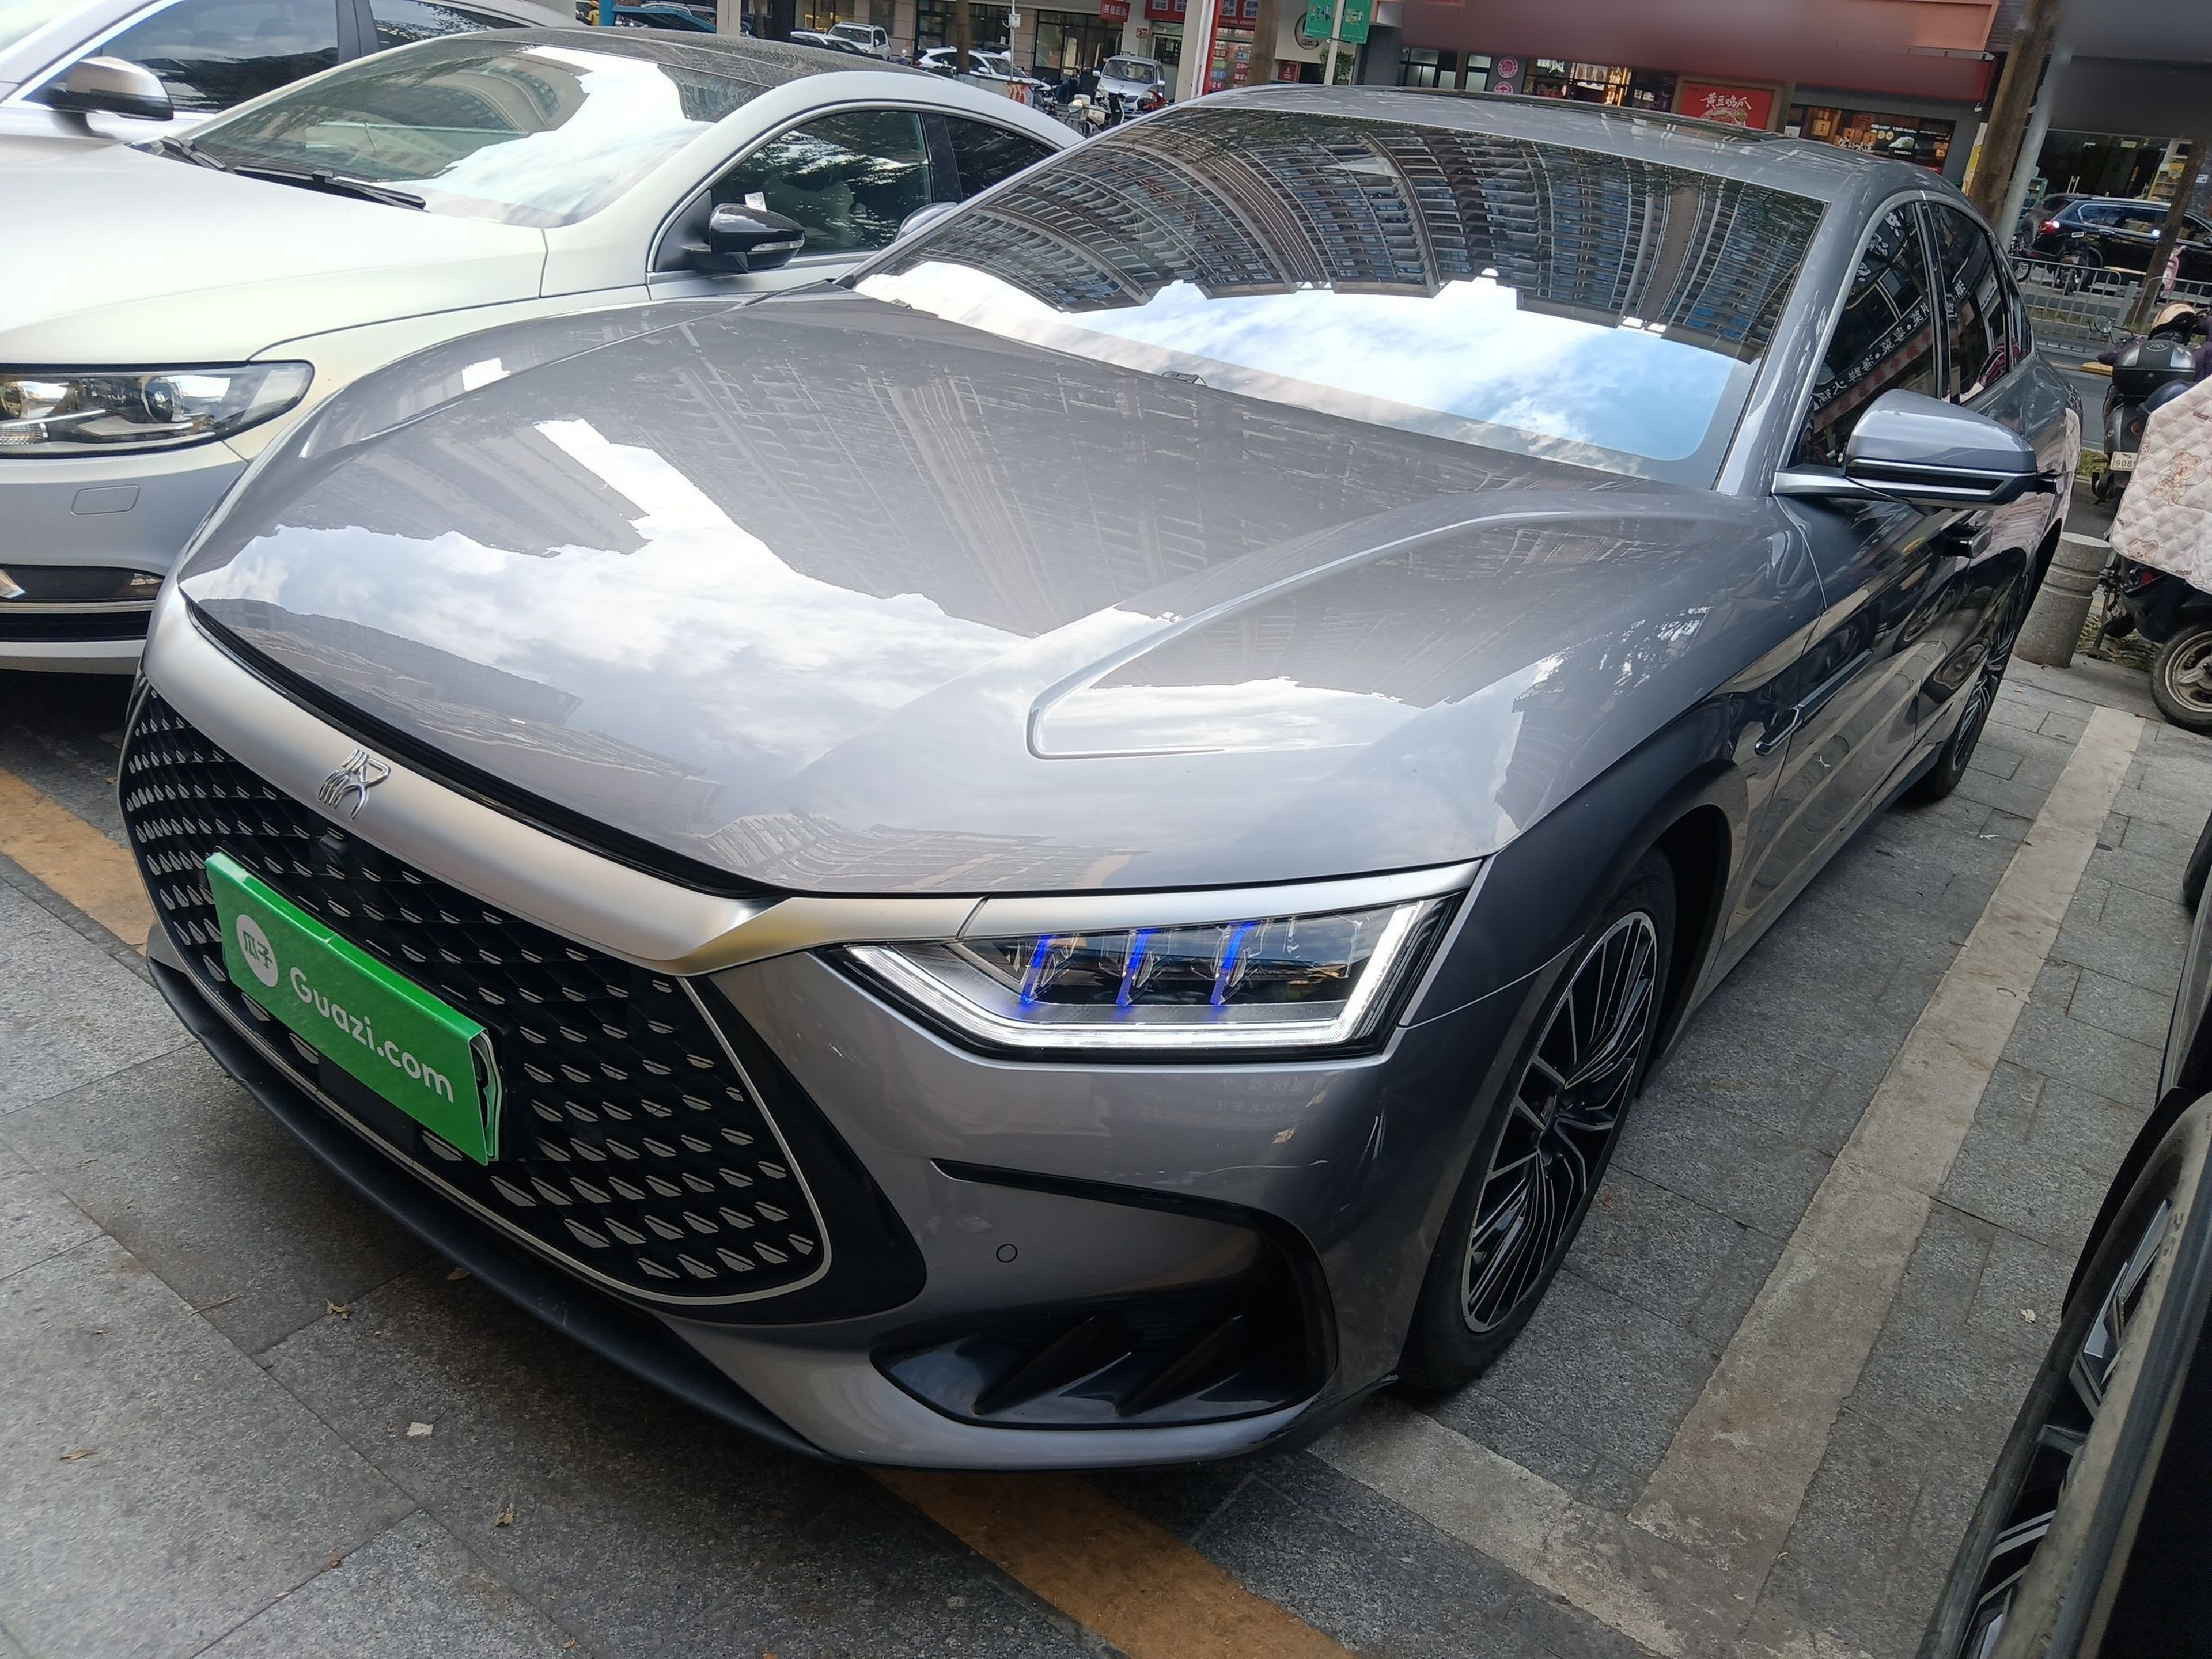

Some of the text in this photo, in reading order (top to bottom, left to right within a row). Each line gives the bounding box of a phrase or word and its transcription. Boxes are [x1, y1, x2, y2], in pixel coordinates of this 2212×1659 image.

[1700, 91, 1752, 111] 黄豆鸡爪
[242, 929, 272, 969] 瓜子
[289, 967, 455, 1103] Guazi.com
